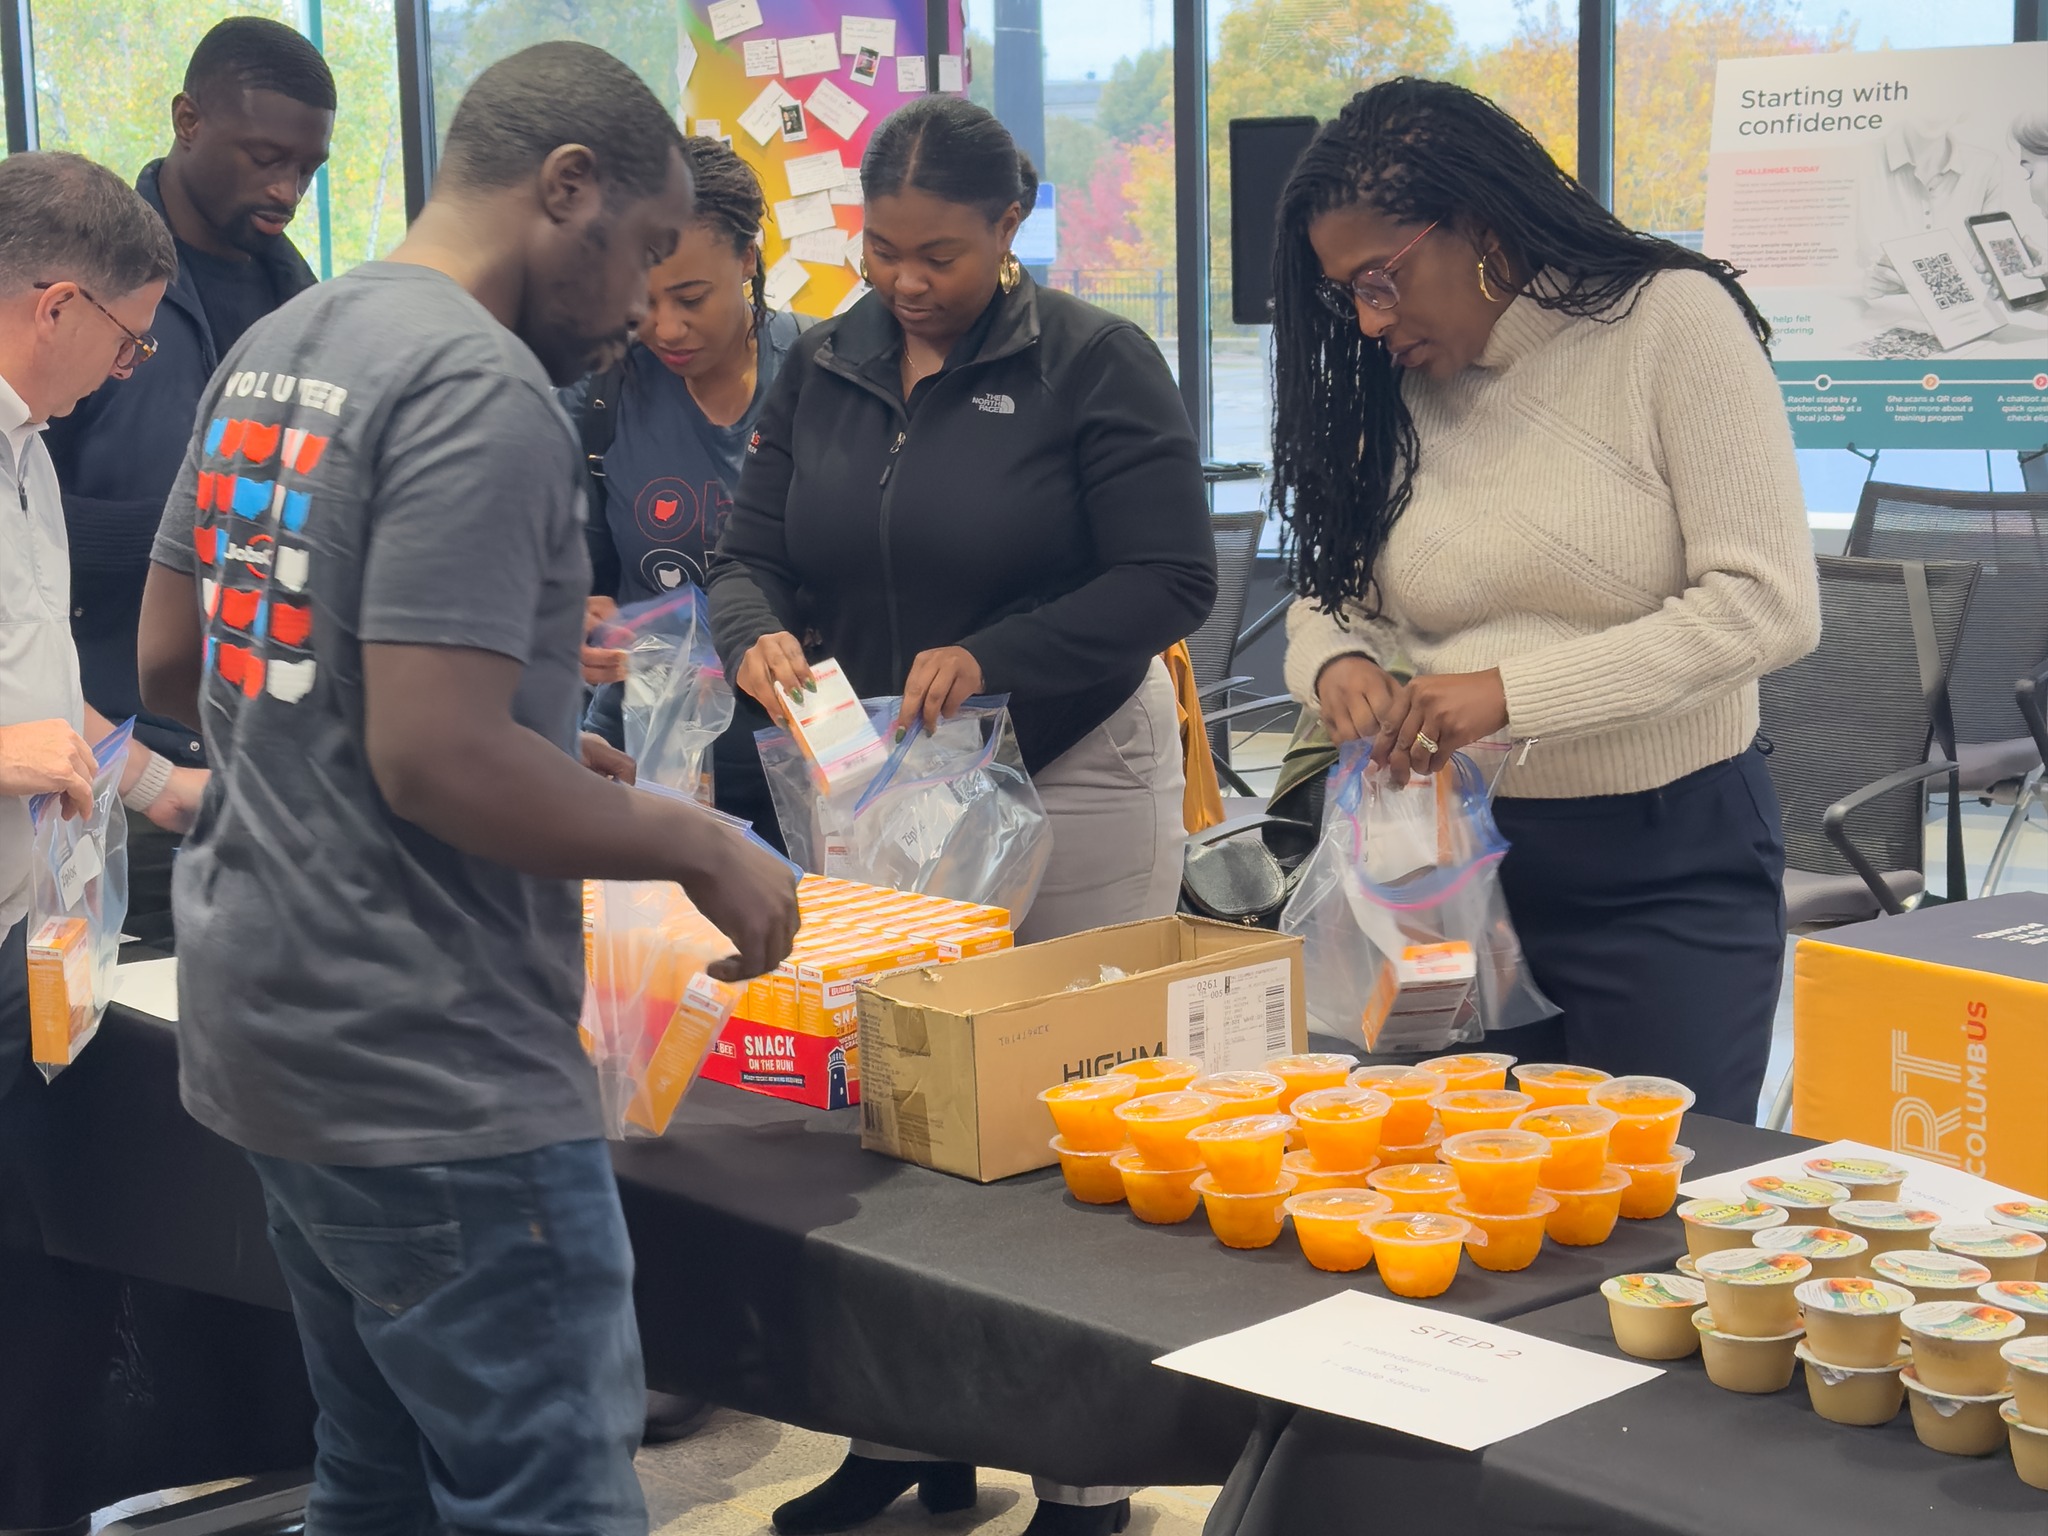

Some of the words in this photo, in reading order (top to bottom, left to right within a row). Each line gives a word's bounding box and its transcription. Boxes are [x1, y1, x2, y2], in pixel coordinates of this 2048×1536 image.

[1741, 86, 1843, 109] Starting
[1852, 80, 1909, 103] with
[1738, 112, 1883, 136] confidence
[1736, 167, 1790, 176] CHALLENGES
[1793, 165, 1820, 174] TODAY
[1773, 315, 1793, 324] help
[1796, 314, 1812, 322] felt
[972, 396, 1001, 407] NORTH
[986, 392, 1001, 401] THE
[1787, 395, 1815, 404] Rachel
[1816, 395, 1838, 405] stops
[1840, 395, 1851, 405] by
[1887, 395, 1903, 403] She
[1936, 395, 1950, 404] QR
[1951, 395, 1973, 403] code
[1997, 395, 2005, 403] A
[2006, 395, 2040, 403] chatbot
[978, 404, 1001, 414] FACE
[1823, 404, 1845, 413] table
[1896, 404, 1917, 412] learn
[1941, 404, 1967, 412] about
[2001, 405, 2025, 413] quick
[1796, 414, 1816, 422] local
[1817, 414, 1831, 423] job
[1832, 414, 1846, 422] fair
[1894, 414, 1926, 423] training
[1927, 414, 1964, 423] program
[1196, 979, 1218, 992] 0261
[1210, 989, 1223, 999] 005
[718, 1043, 734, 1055] BEE
[744, 1035, 796, 1058] SNACK
[748, 1058, 760, 1070] ON
[761, 1059, 775, 1071] THE
[776, 1060, 794, 1072] RUN!
[1700, 1205, 1738, 1219] MOTT'S
[1410, 1325, 1495, 1350] STEP
[1495, 1349, 1522, 1360] 2
[1363, 1345, 1433, 1369] mandarin
[1434, 1365, 1489, 1384] orange
[1383, 1363, 1409, 1374] OR
[1341, 1364, 1384, 1381] apple
[1385, 1376, 1431, 1394] sauce
